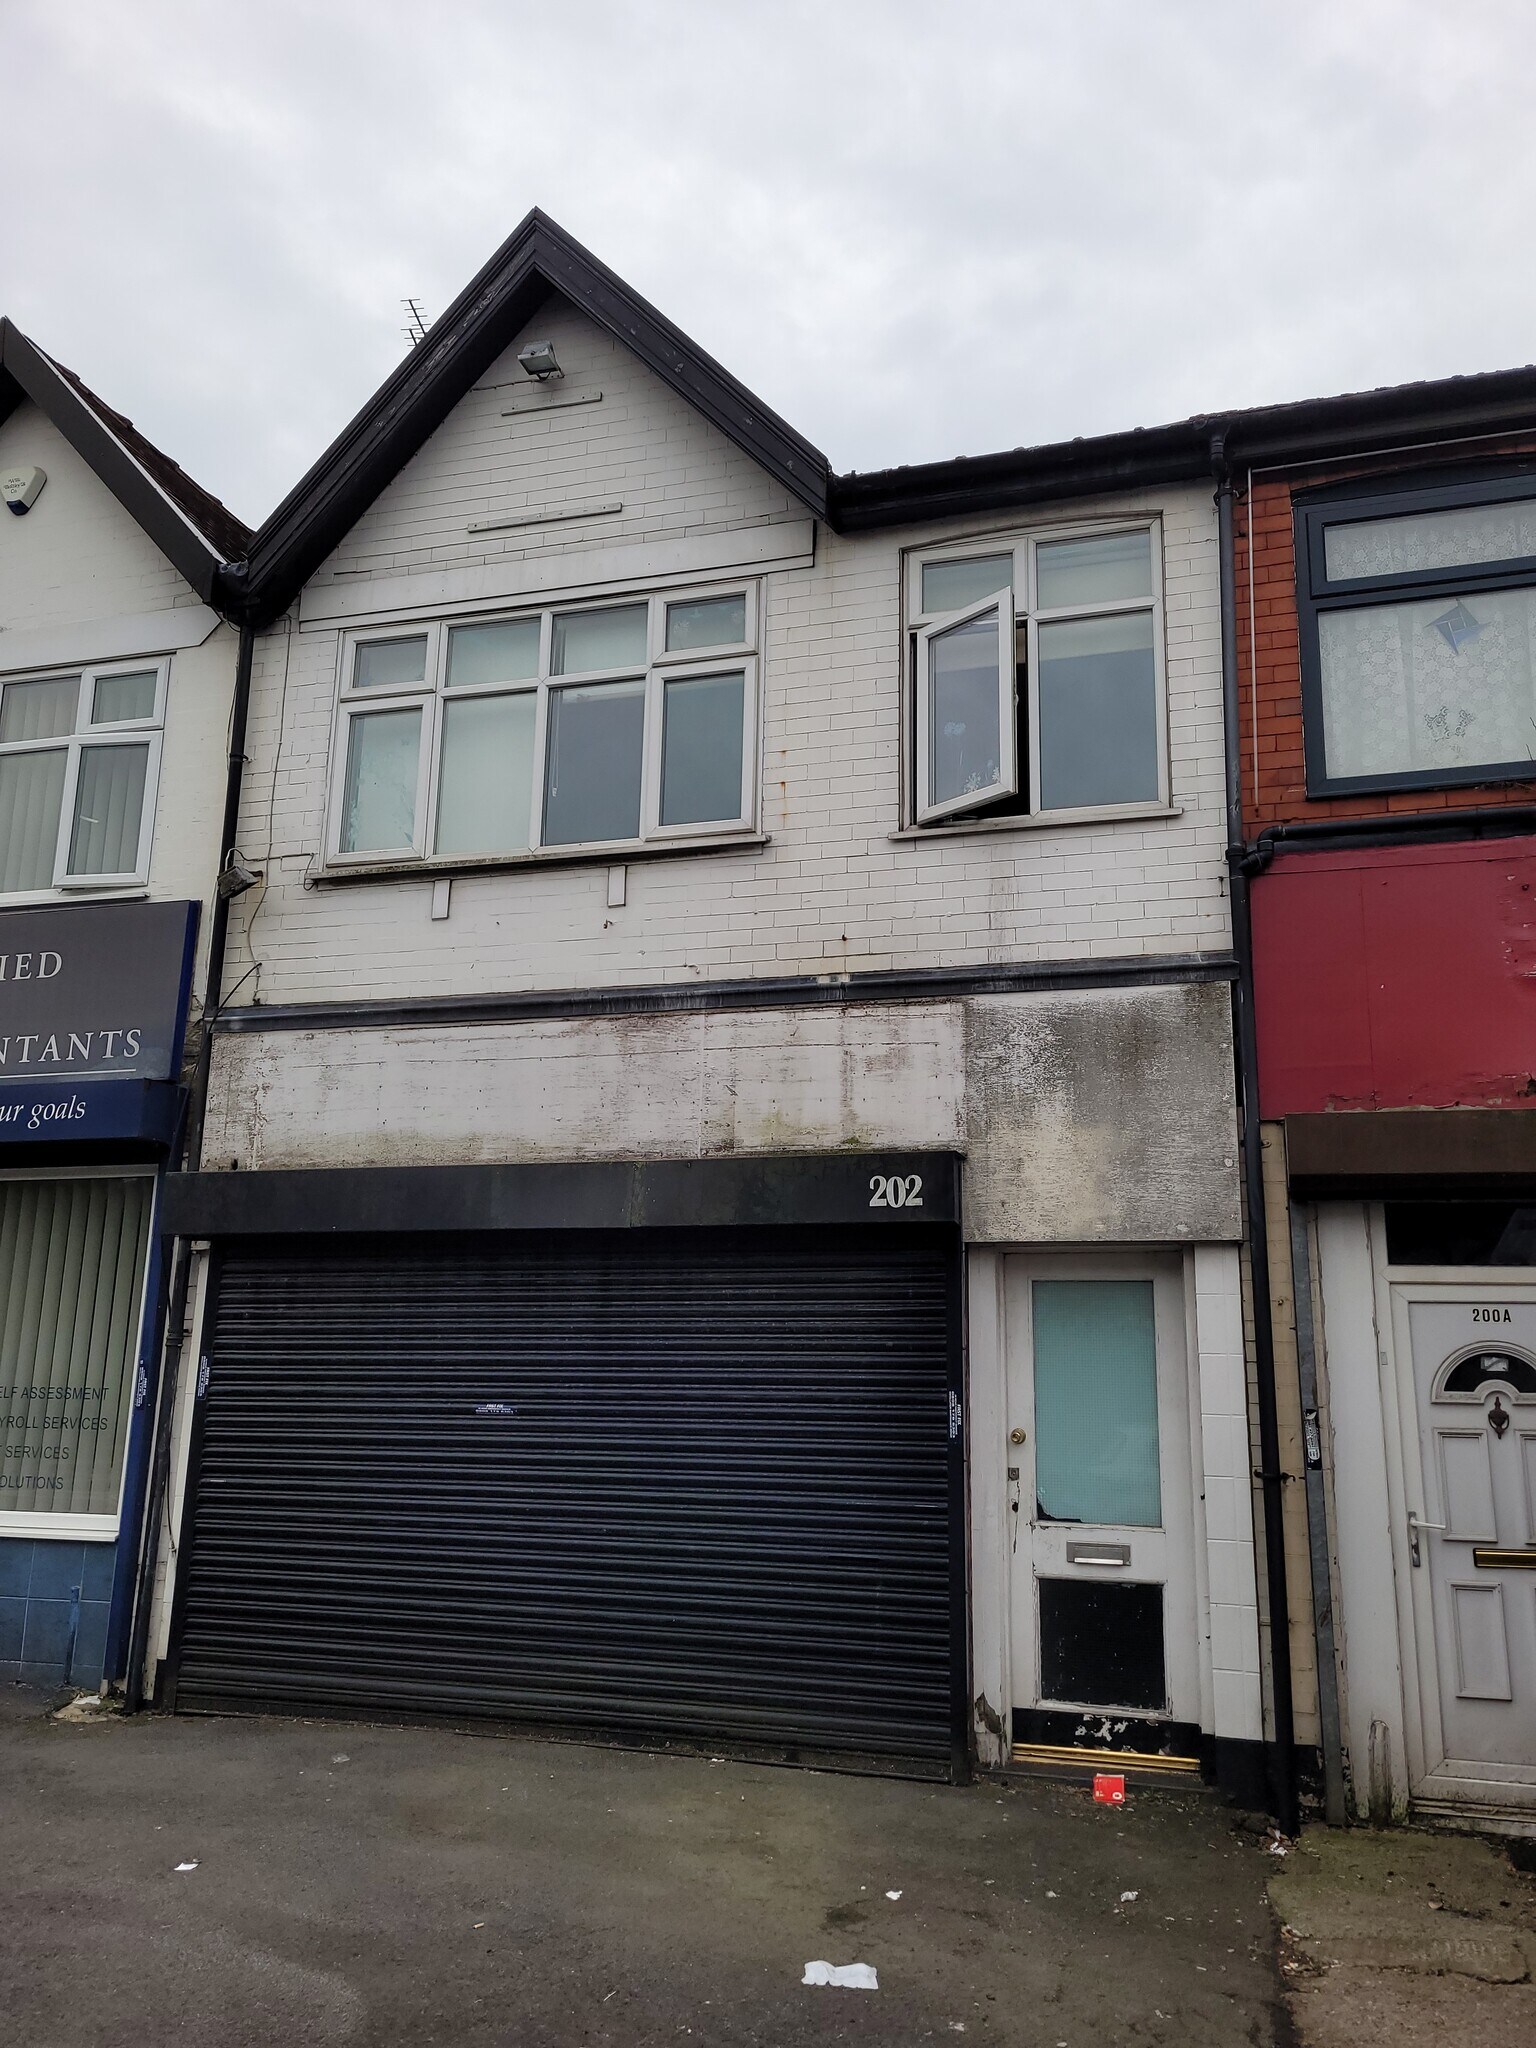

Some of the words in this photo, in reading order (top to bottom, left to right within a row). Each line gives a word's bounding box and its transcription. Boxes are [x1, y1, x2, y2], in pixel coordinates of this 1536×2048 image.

[0, 951, 63, 982] IED
[27, 1095, 87, 1130] goals
[869, 1174, 923, 1208] 202
[1472, 1308, 1512, 1323] 200A
[20, 1386, 109, 1400] ASSESSMENT
[0, 1415, 39, 1429] YROLL
[43, 1416, 109, 1431] SERVICES
[5, 1445, 70, 1460] SERVICES
[0, 1475, 64, 1489] OLUTIONS
